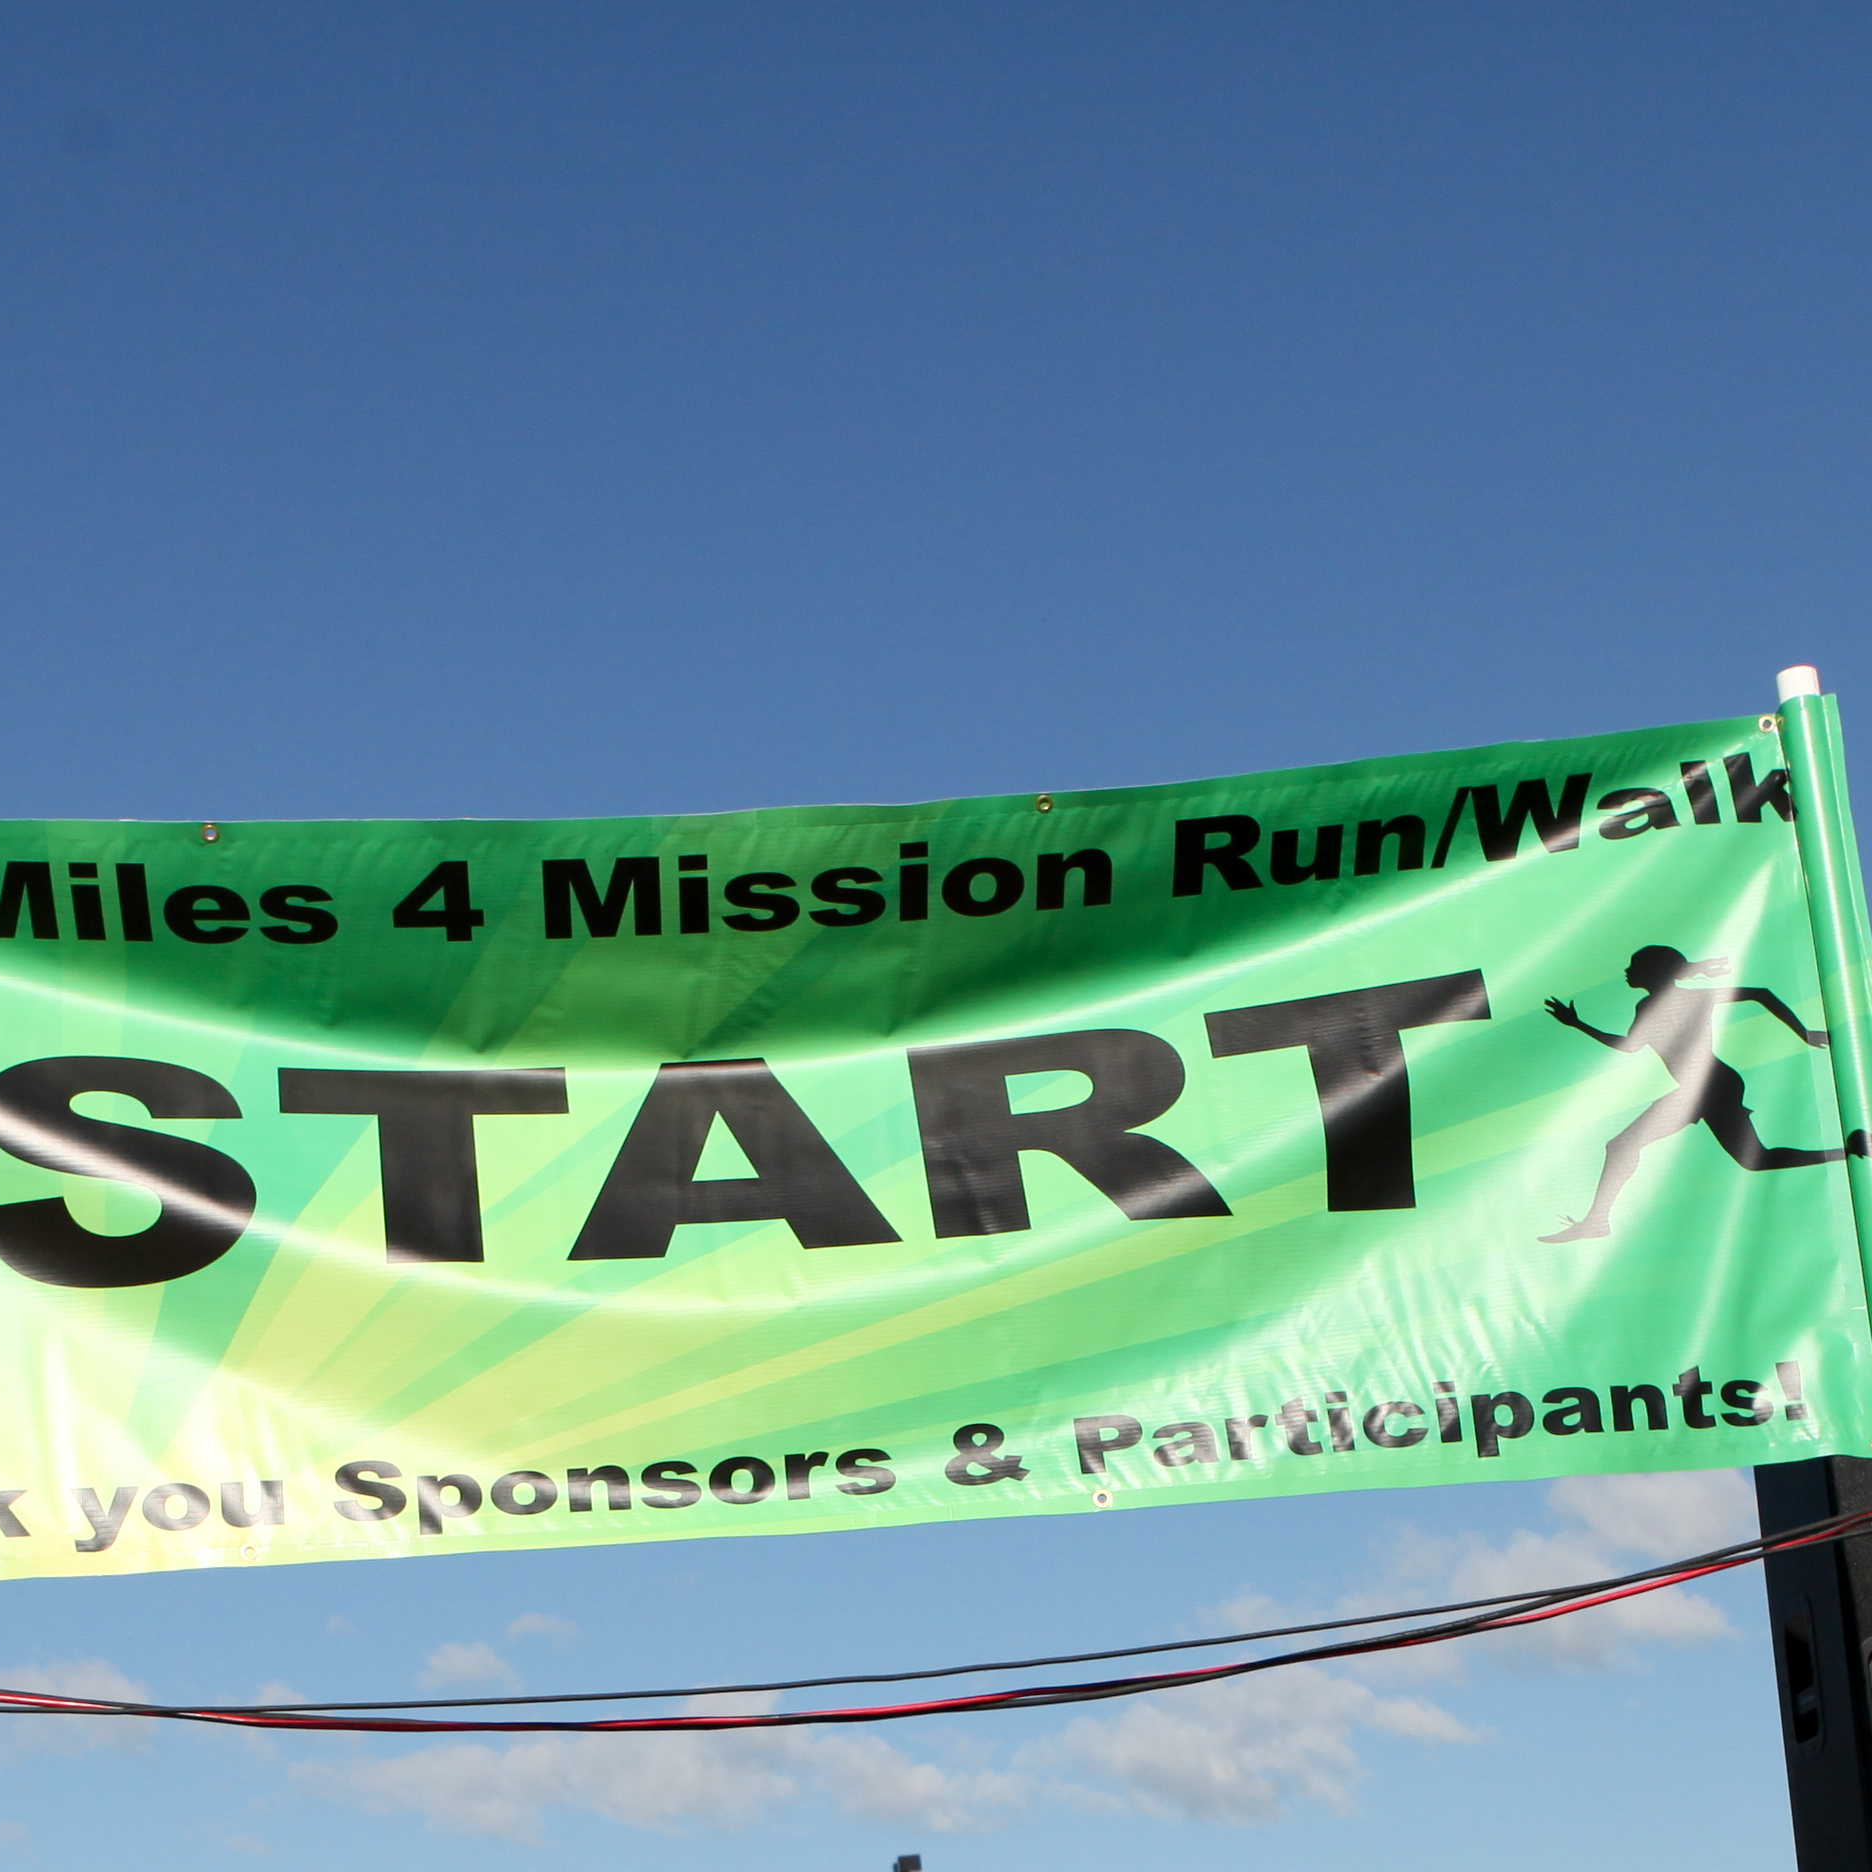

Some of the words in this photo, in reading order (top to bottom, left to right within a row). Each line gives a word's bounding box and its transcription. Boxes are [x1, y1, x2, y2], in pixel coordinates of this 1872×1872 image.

[391, 860, 485, 944] 4
[540, 841, 1115, 941] Mission
[1171, 751, 1799, 899] Run/Walk
[72, 1468, 287, 1553] you
[332, 1446, 897, 1536] Sponsors
[946, 1422, 1032, 1488] &
[1072, 1359, 1809, 1476] Participants!
